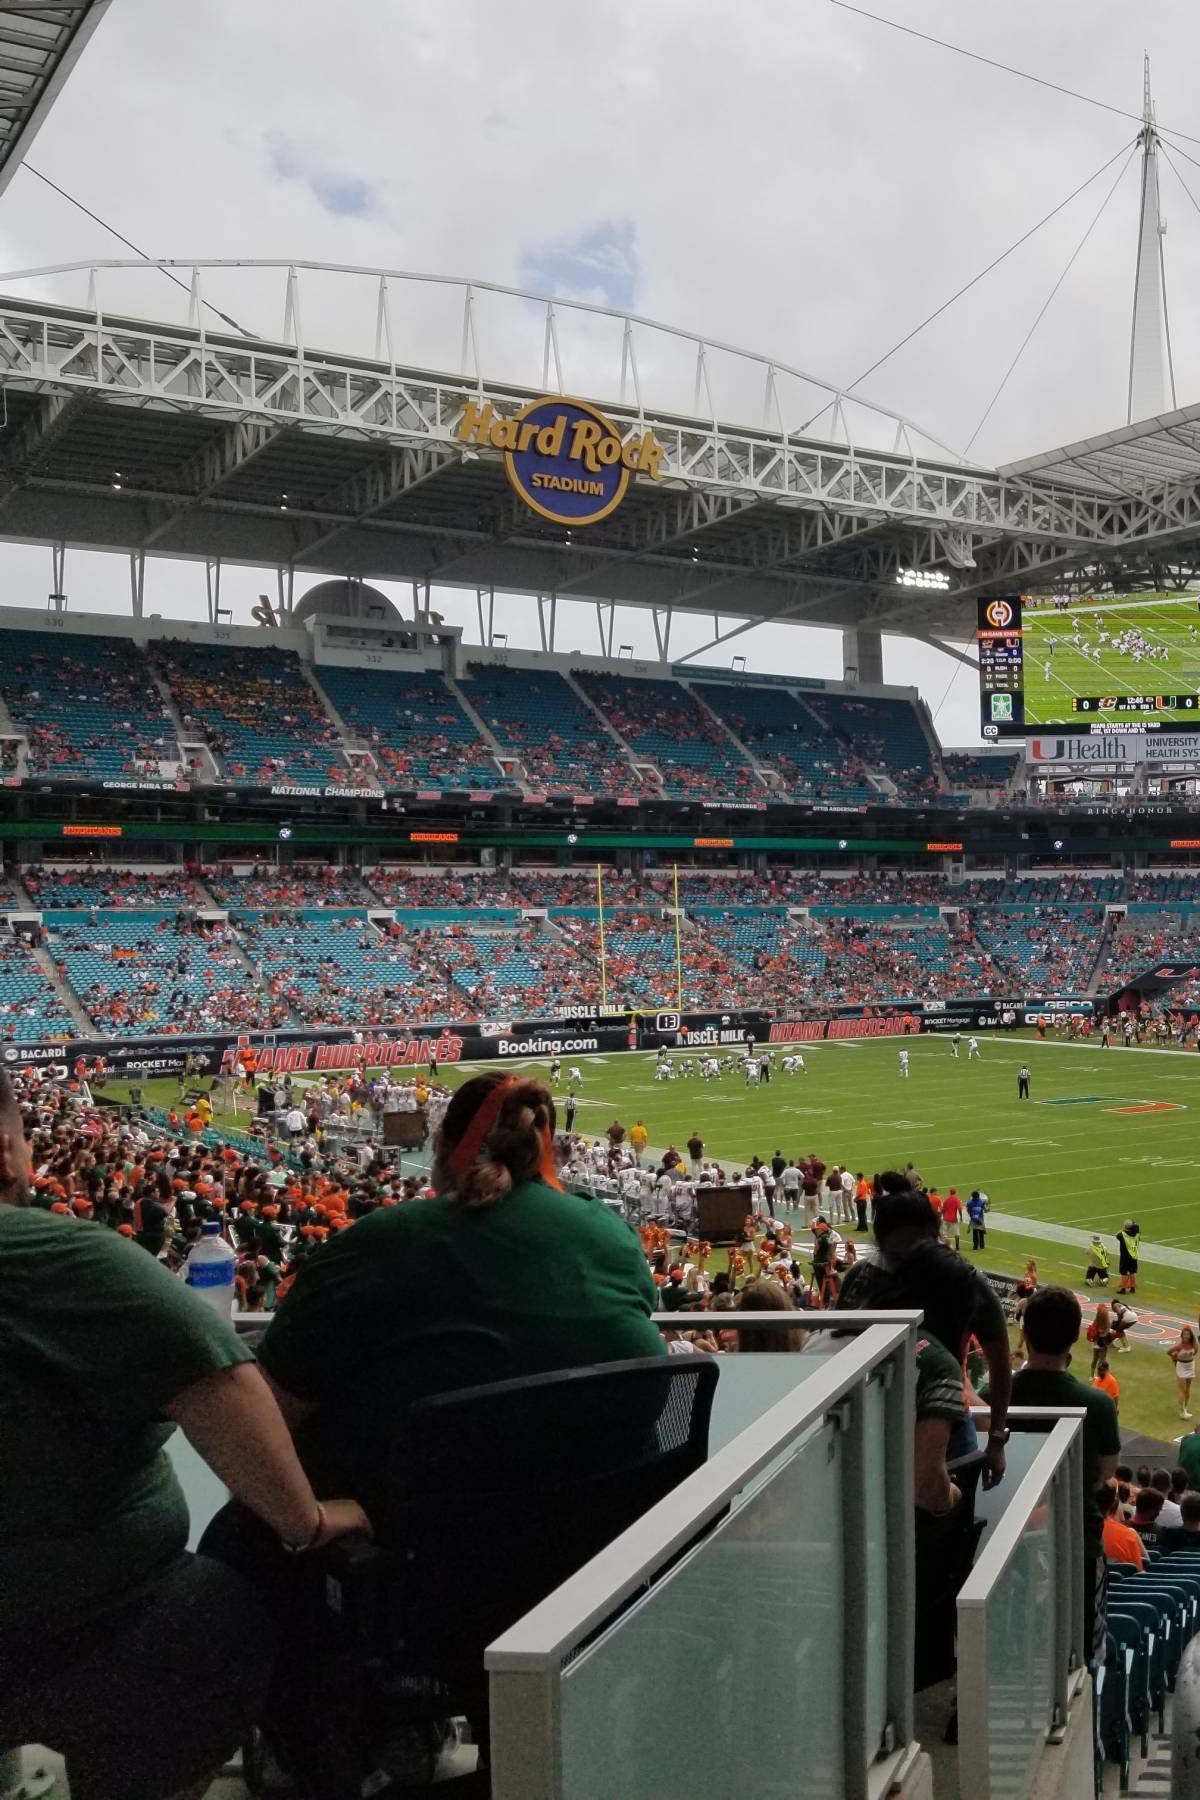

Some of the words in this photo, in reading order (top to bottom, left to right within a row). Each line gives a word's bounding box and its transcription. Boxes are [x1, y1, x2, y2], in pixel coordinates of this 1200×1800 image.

[457, 400, 567, 457] Hard
[569, 418, 664, 481] Rock
[531, 472, 604, 497] STADIUM
[44, 618, 64, 627] 330
[213, 631, 231, 640] 331
[365, 655, 383, 664] 332
[1082, 701, 1090, 710] 0
[1185, 698, 1193, 707] 0
[984, 727, 997, 735] CC
[1146, 737, 1198, 747] UNIVERSITY
[1146, 749, 1180, 758] HEALTH
[102, 781, 138, 789] GEORGE
[139, 782, 160, 790] MIRA
[271, 786, 322, 796] NATIONAL
[324, 787, 385, 798] CHAMPIONS
[664, 1015, 676, 1028] 13
[769, 1021, 827, 1042] MIAMI
[827, 1015, 921, 1040] HURRICANS
[720, 1029, 746, 1042] MILK
[498, 1037, 598, 1055] Booking.com
[20, 1046, 66, 1059] BACARDÍ
[126, 1059, 166, 1070] ROCKET
